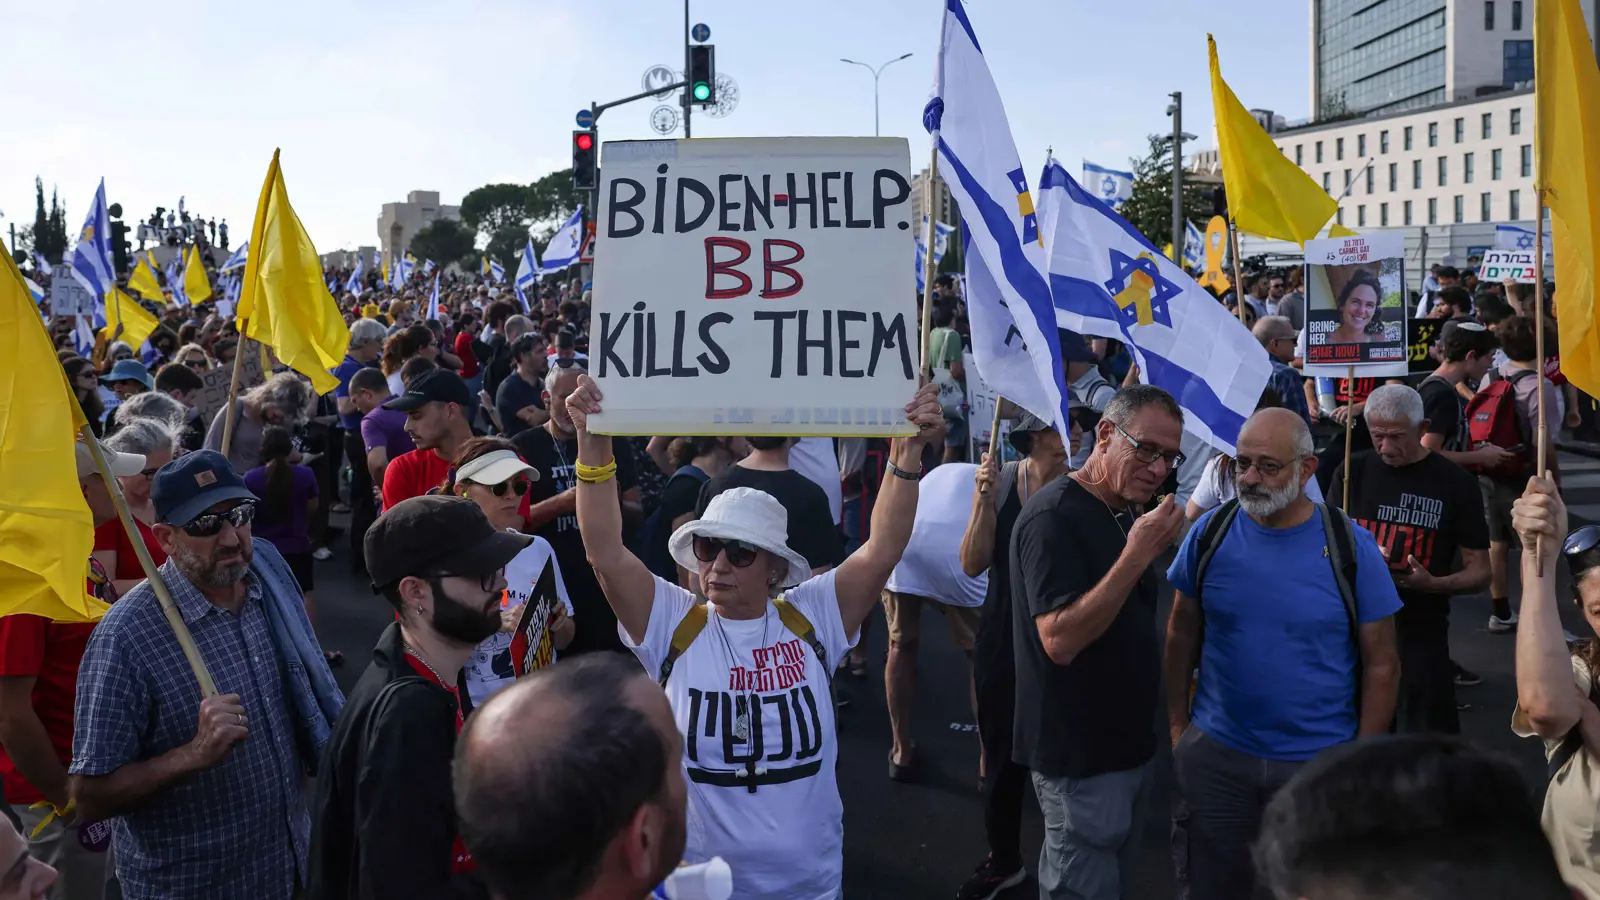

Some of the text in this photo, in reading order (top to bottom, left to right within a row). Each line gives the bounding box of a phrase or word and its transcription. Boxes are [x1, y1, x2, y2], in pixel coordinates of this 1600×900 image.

[1338, 245, 1370, 255] CARMEL GAT
[1486, 253, 1537, 264] בחרת
[704, 236, 805, 299] BB
[1481, 265, 1537, 279] בחיים!
[1309, 320, 1336, 333] BRING
[753, 309, 915, 380] THEM
[1309, 333, 1326, 345] HER
[1309, 344, 1360, 358] HOME NOW!
[1400, 493, 1443, 515] מחזירים
[1377, 504, 1440, 529] אותם הביתה
[729, 660, 806, 692] אותם הביתה
[687, 685, 823, 764] עכשיו
